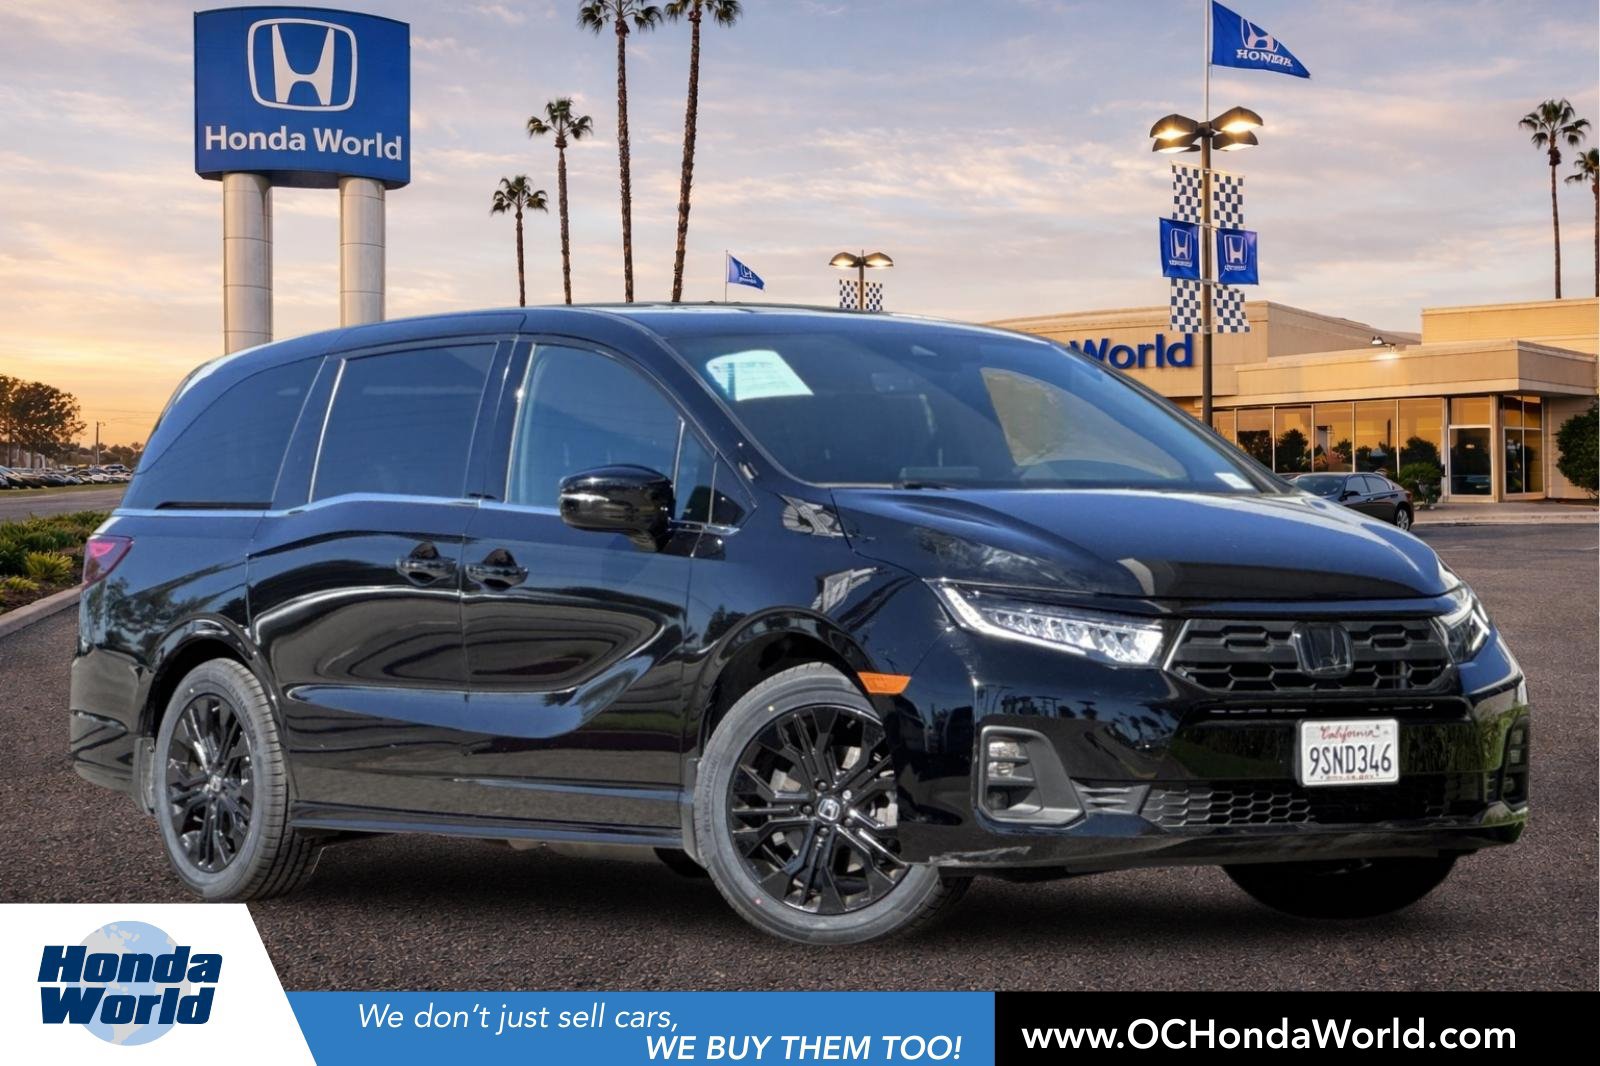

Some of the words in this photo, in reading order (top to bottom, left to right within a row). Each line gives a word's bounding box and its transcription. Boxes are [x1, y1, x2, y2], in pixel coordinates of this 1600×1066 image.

[205, 125, 306, 151] Honda
[312, 127, 402, 160] World
[1069, 333, 1193, 369] World
[1319, 725, 1380, 743] California
[1310, 744, 1392, 776] 9SND346
